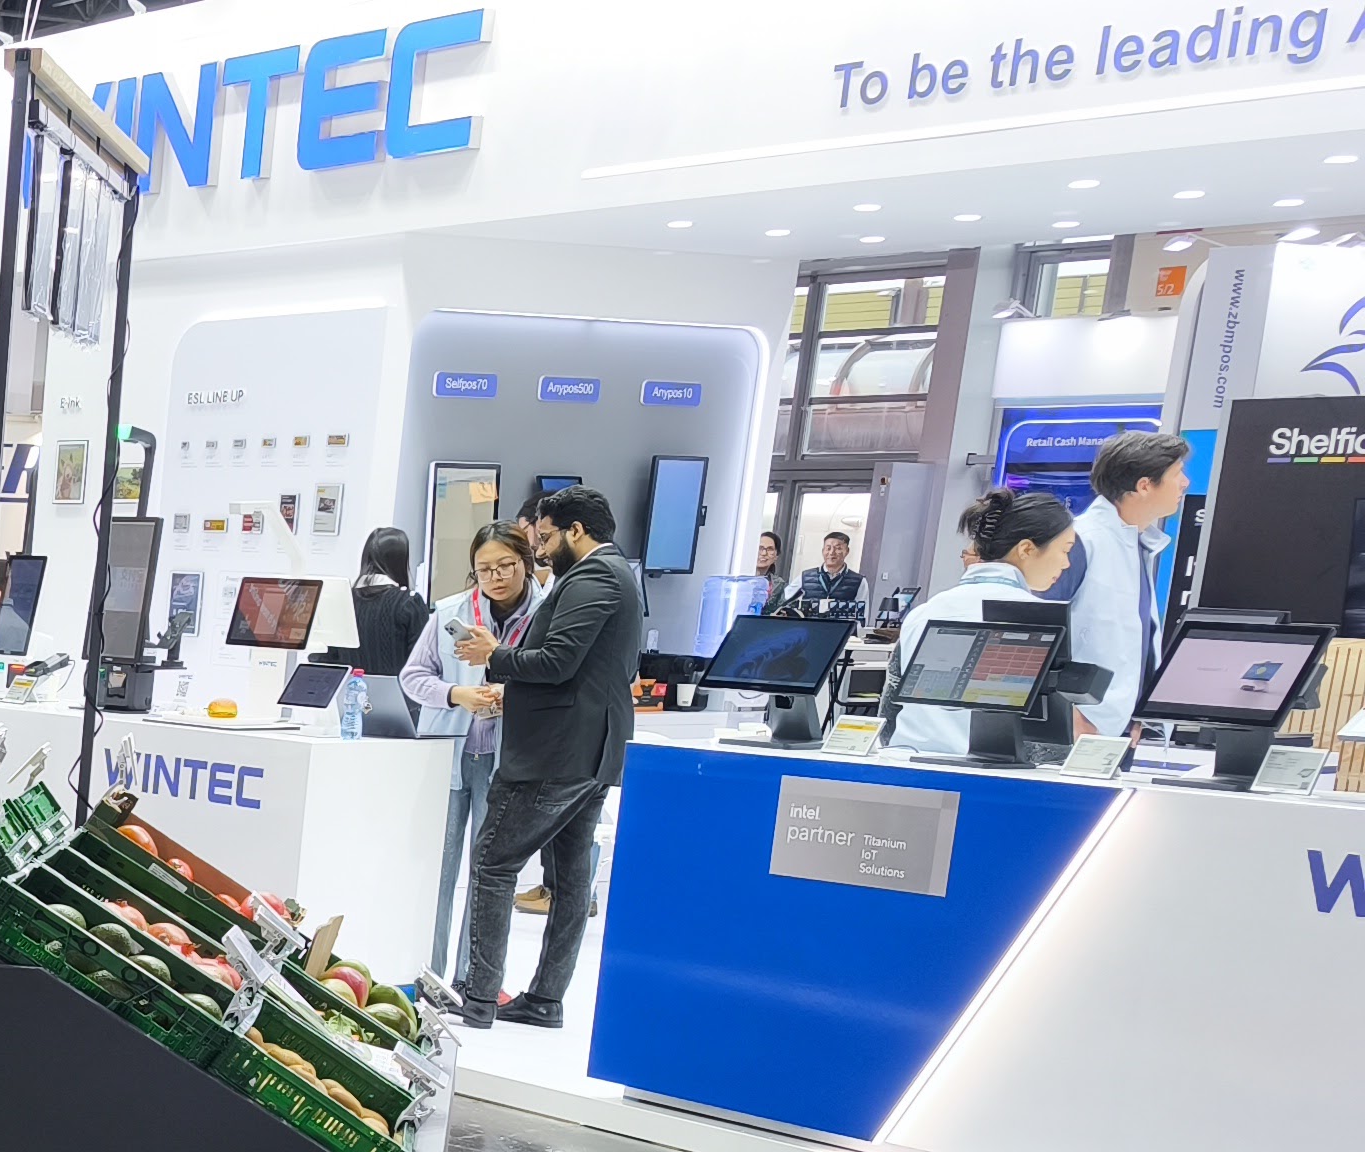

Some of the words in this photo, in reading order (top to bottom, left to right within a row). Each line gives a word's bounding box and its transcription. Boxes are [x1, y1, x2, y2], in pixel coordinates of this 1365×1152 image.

[833, 60, 888, 108] To
[907, 53, 969, 99] be
[989, 37, 1075, 89] the
[1095, 7, 1328, 75] leading
[1157, 284, 1174, 295] 5/2
[1212, 268, 1246, 409] www.zbmpos.com
[444, 376, 488, 394] Selfpos70
[546, 380, 593, 398] Anypos500
[187, 392, 205, 405] ESL
[206, 391, 228, 404] LINE
[230, 389, 244, 403] UP
[1026, 437, 1052, 448] Retail
[1054, 437, 1076, 447] Cash
[105, 748, 265, 810] WINTEC
[787, 825, 855, 847] partner
[863, 834, 907, 850] Titanium
[861, 849, 878, 861] IoT
[859, 862, 905, 879] Solutions
